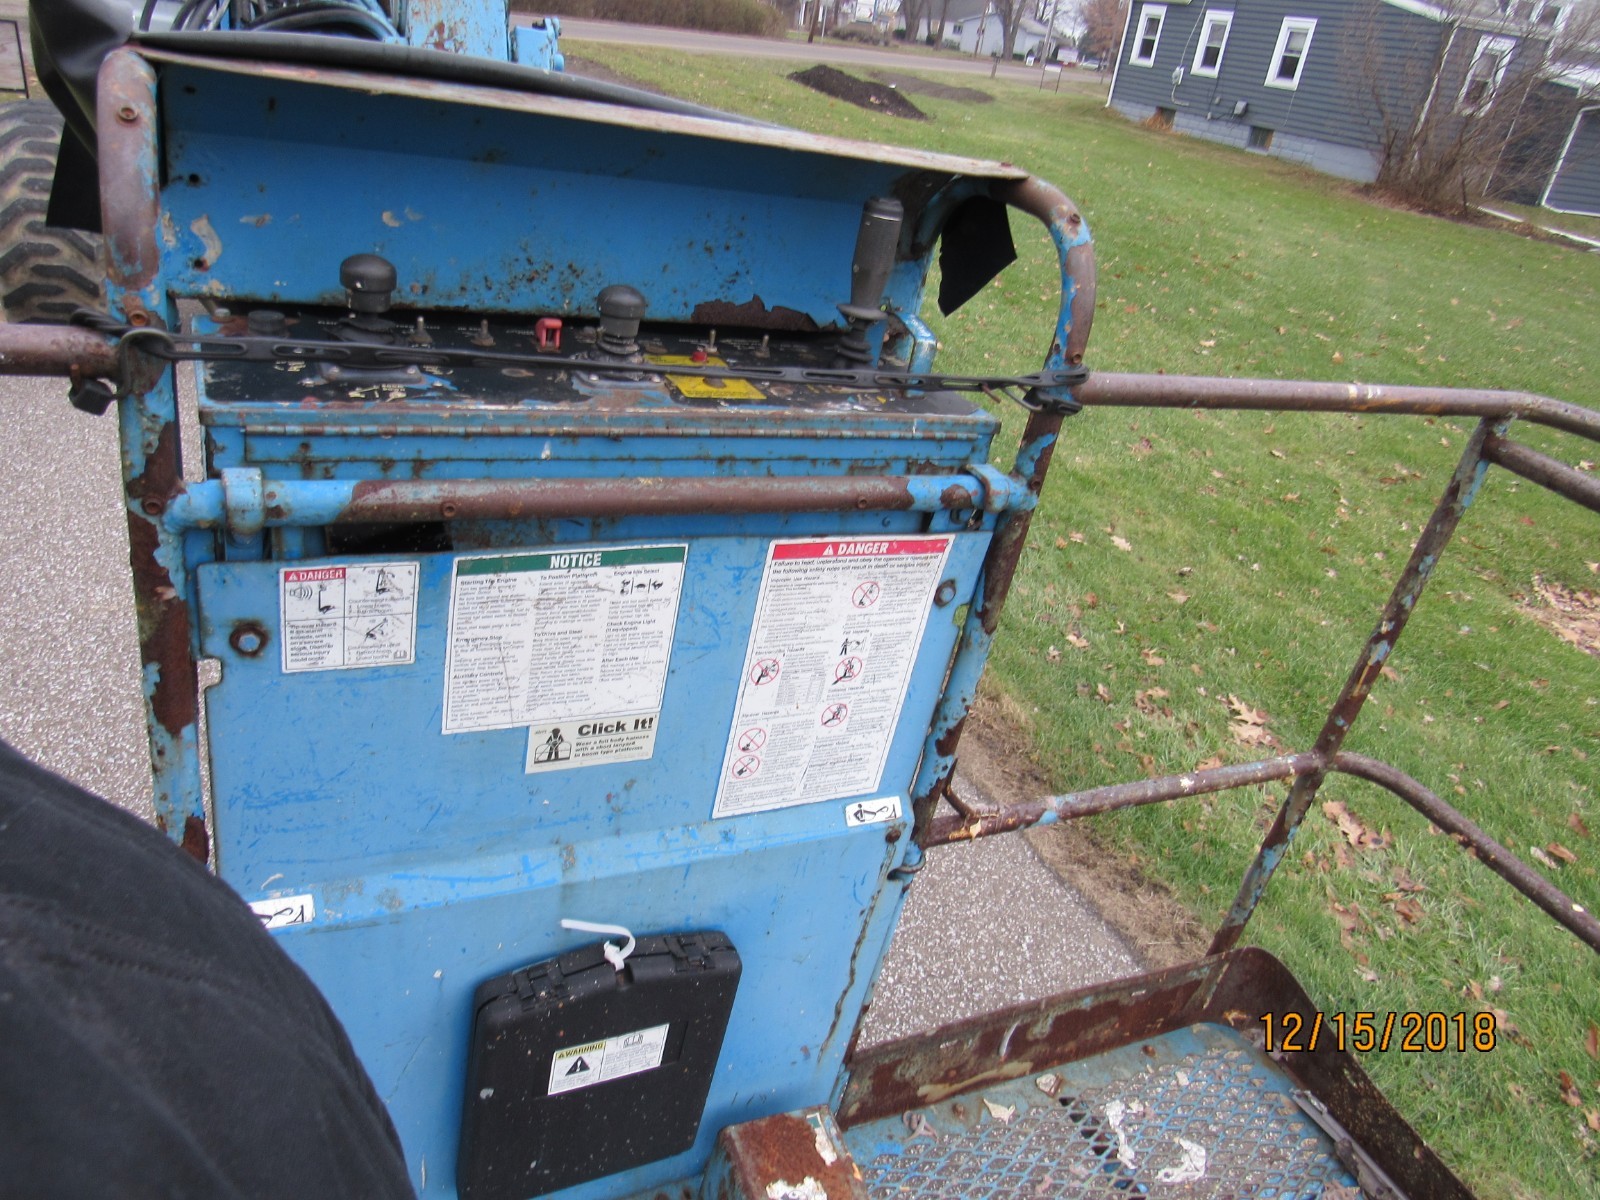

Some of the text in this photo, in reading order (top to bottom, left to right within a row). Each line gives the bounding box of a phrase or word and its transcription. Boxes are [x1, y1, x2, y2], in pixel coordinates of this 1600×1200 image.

[837, 542, 889, 555] DANGER
[550, 552, 602, 569] NOTICE
[300, 569, 343, 580] DANGER
[578, 717, 654, 736] Click It!
[566, 1042, 604, 1057] WARNING
